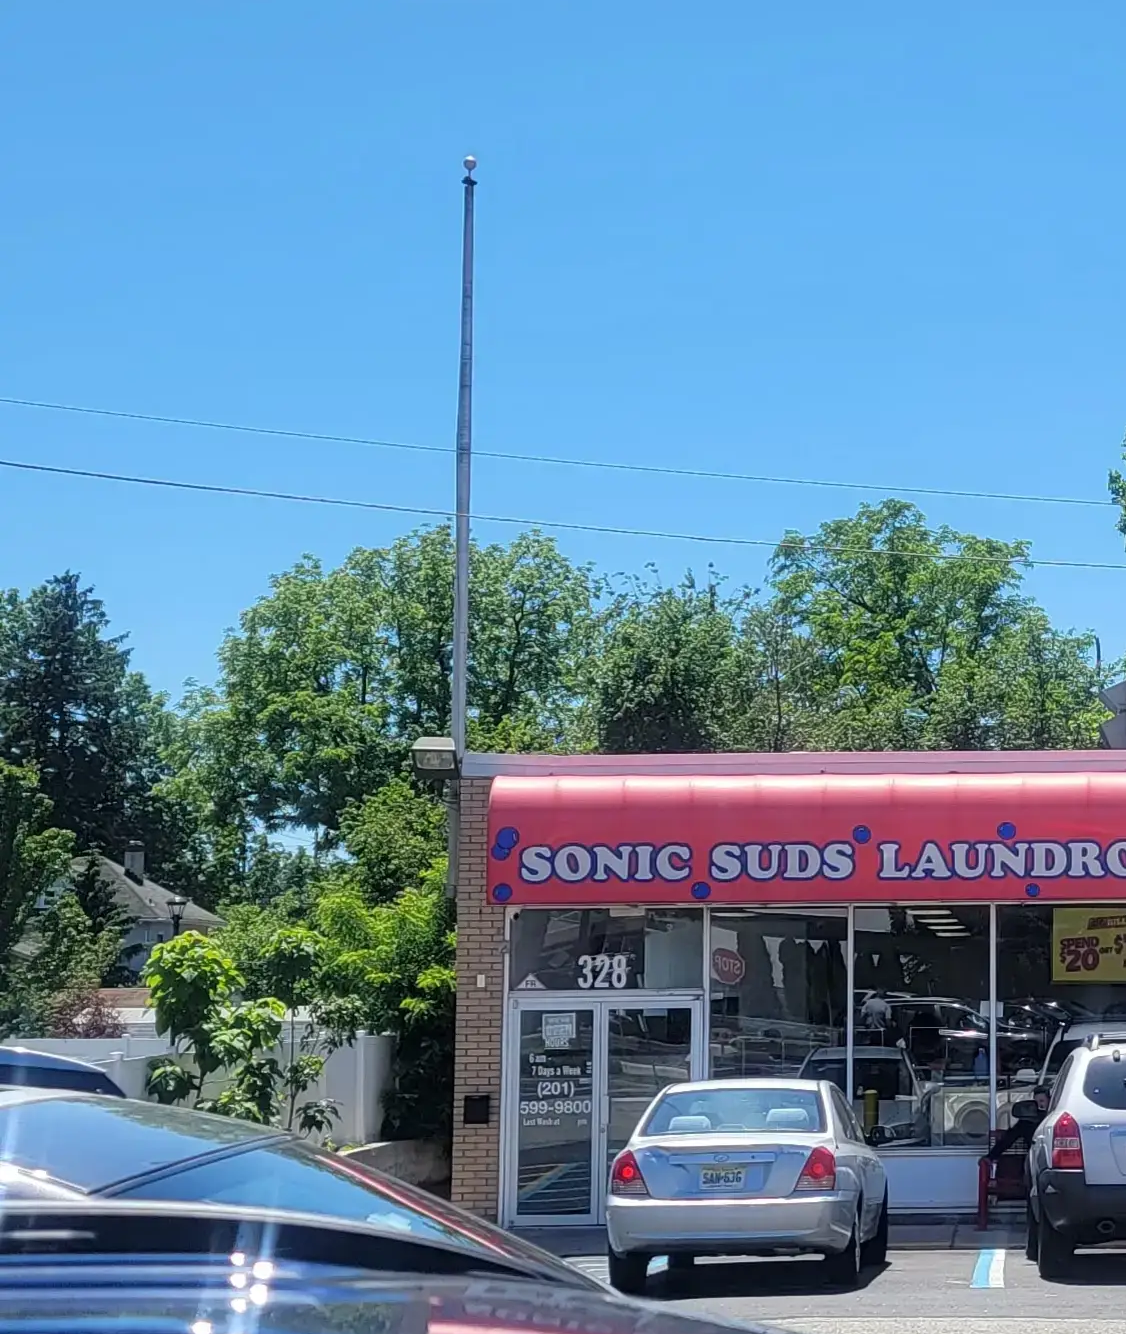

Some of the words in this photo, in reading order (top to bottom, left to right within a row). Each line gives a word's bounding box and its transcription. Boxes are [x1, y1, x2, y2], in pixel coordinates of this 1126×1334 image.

[520, 844, 692, 882] SONIC
[710, 842, 855, 881] SUDS
[1060, 936, 1099, 948] SPEND
[1060, 948, 1100, 972] $20
[577, 955, 627, 989] 328
[525, 979, 537, 988] FR
[538, 1066, 555, 1077] Days
[562, 1066, 581, 1075] Week
[537, 1082, 575, 1098] (201)
[520, 1101, 591, 1114] 599-9800
